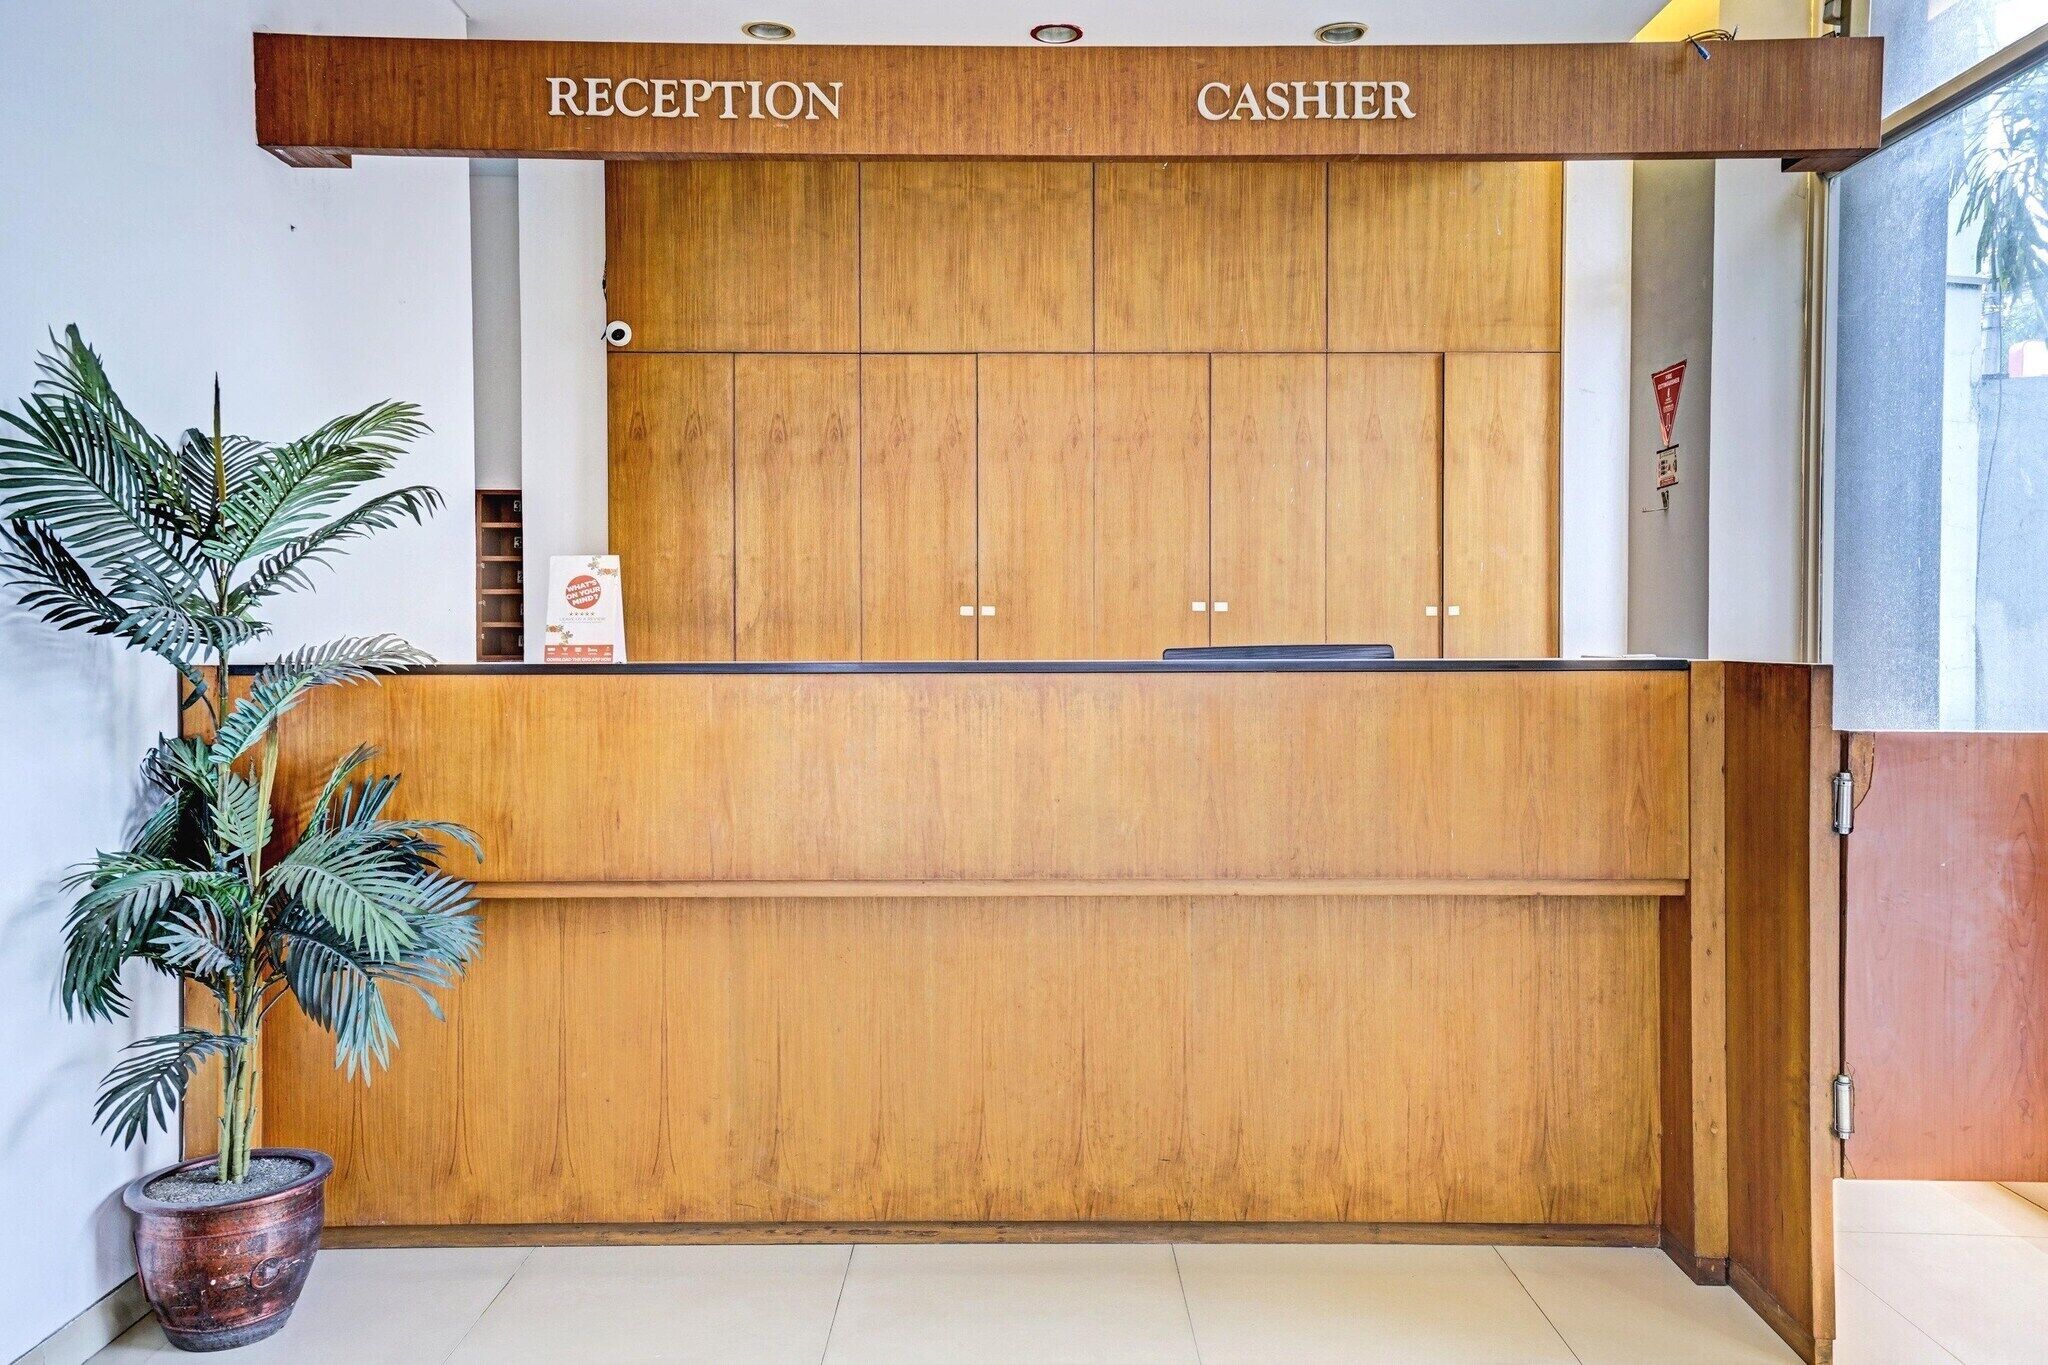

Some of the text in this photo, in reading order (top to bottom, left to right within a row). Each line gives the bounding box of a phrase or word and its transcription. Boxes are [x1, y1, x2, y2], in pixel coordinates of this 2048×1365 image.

[546, 77, 843, 120] RECEPTION
[1197, 80, 1417, 121] CASHIER
[566, 586, 601, 600] ON YOUR
